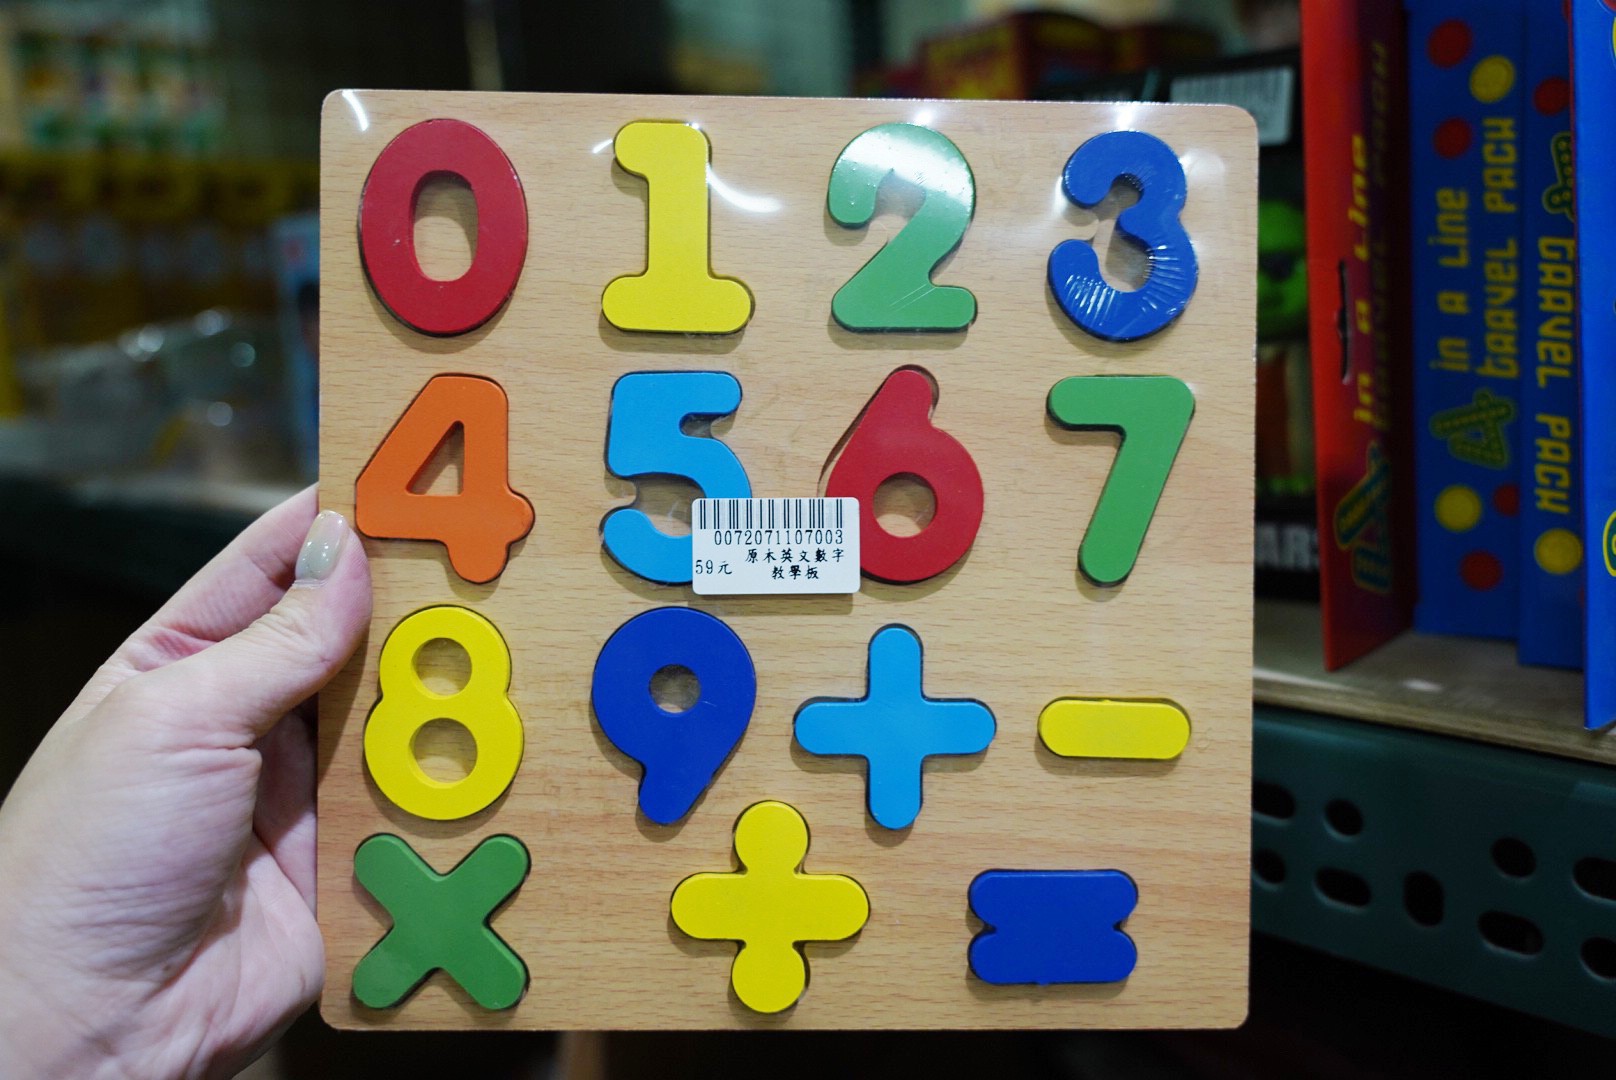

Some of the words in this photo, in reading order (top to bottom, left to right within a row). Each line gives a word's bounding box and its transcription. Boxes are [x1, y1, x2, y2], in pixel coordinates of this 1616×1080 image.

[358, 118, 528, 336] 0
[602, 121, 755, 334] 1
[828, 122, 977, 332] 2
[1048, 130, 1199, 342] 3
[355, 372, 535, 584] 4
[600, 371, 752, 585] 5
[824, 366, 984, 583] 6
[1047, 375, 1195, 585] 7
[714, 530, 844, 545] 0072071107003
[745, 549, 844, 563] 原木英文數字
[695, 559, 733, 575] 59元
[771, 565, 820, 580] 教學板
[363, 605, 524, 820] 8
[592, 606, 756, 825] 9
